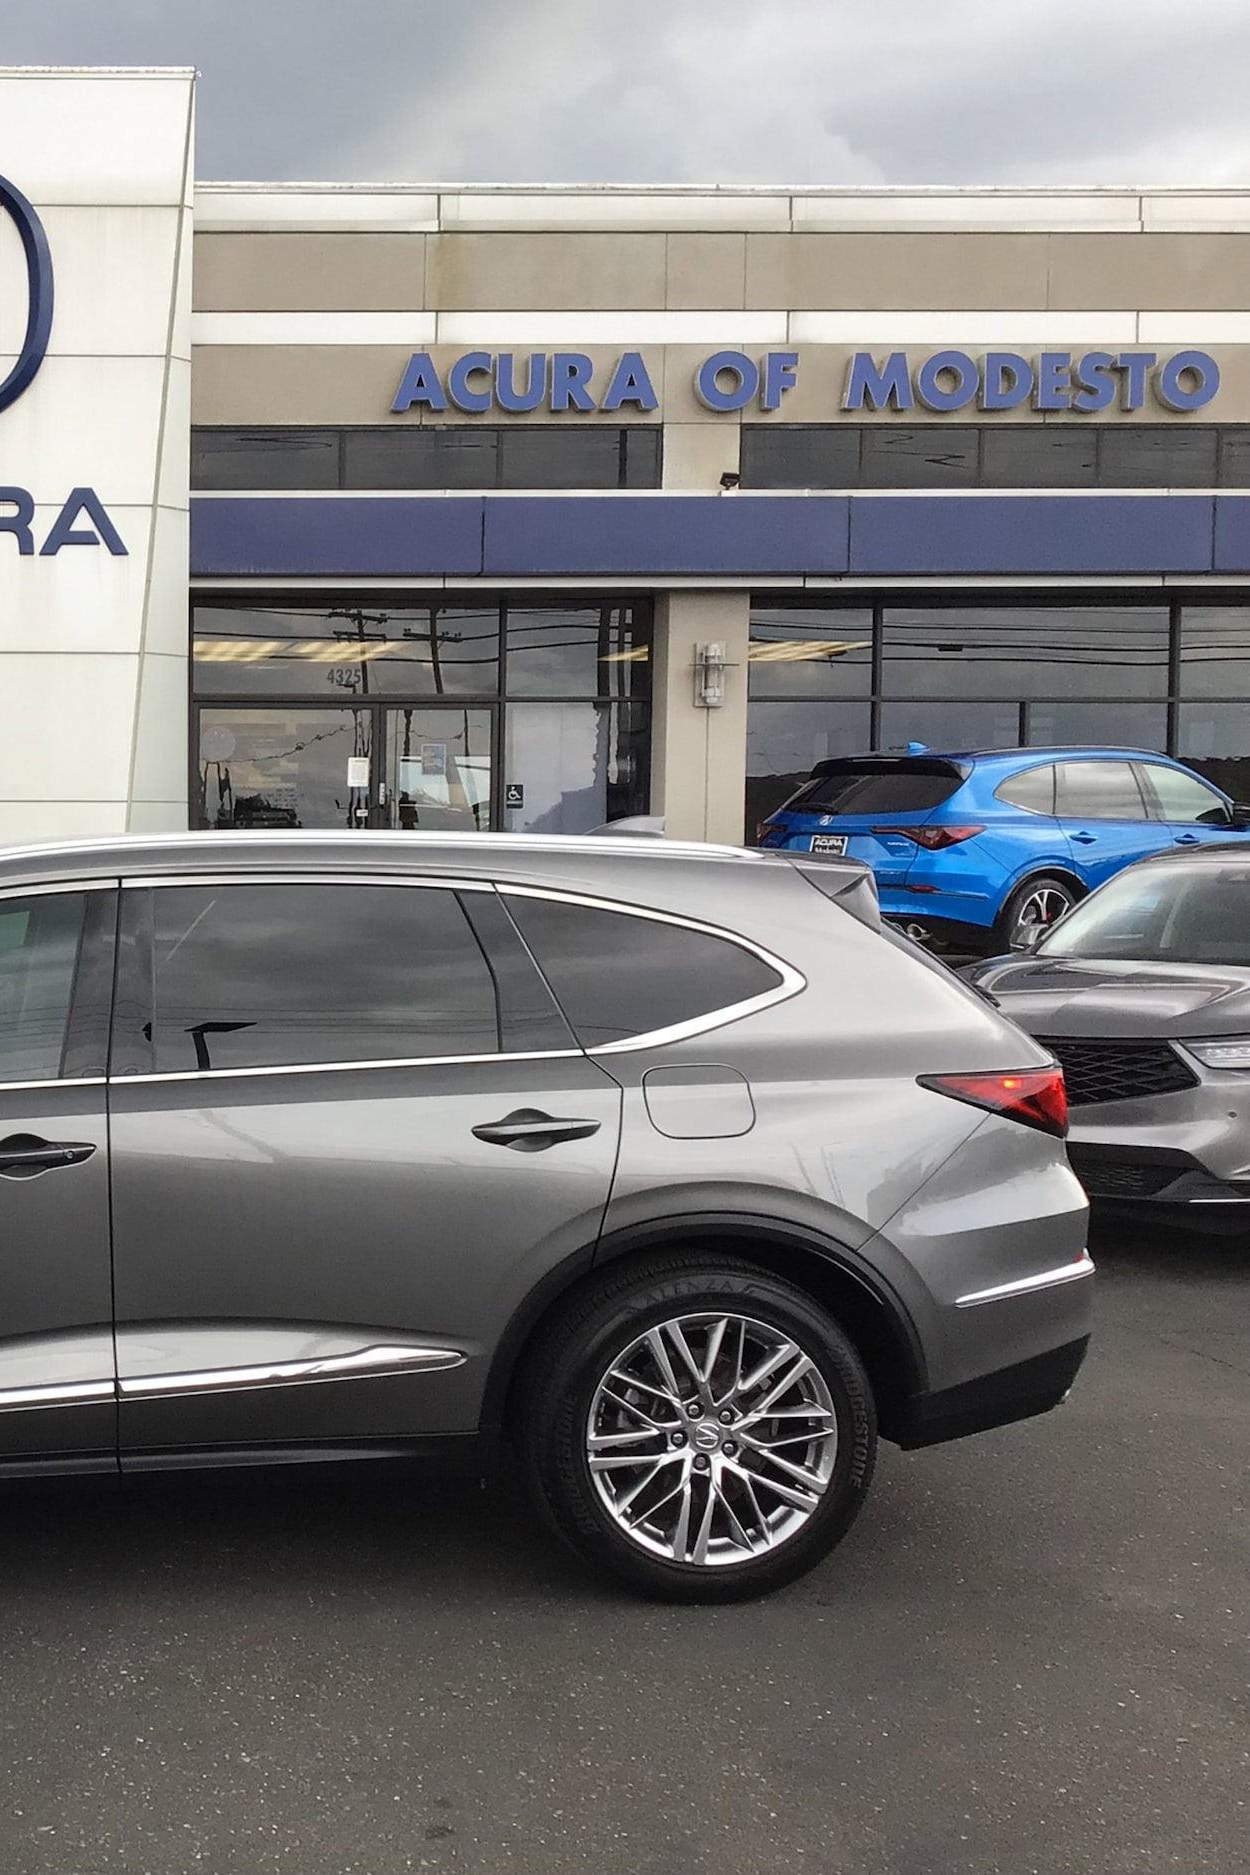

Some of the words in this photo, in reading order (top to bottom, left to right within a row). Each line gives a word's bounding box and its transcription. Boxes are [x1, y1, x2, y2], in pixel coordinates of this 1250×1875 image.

[390, 350, 660, 413] ACURA
[694, 349, 799, 413] OF
[840, 349, 1221, 413] MODESTO
[326, 668, 361, 685] 4325
[814, 838, 844, 847] ACURA
[644, 1279, 735, 1306] ALENZA
